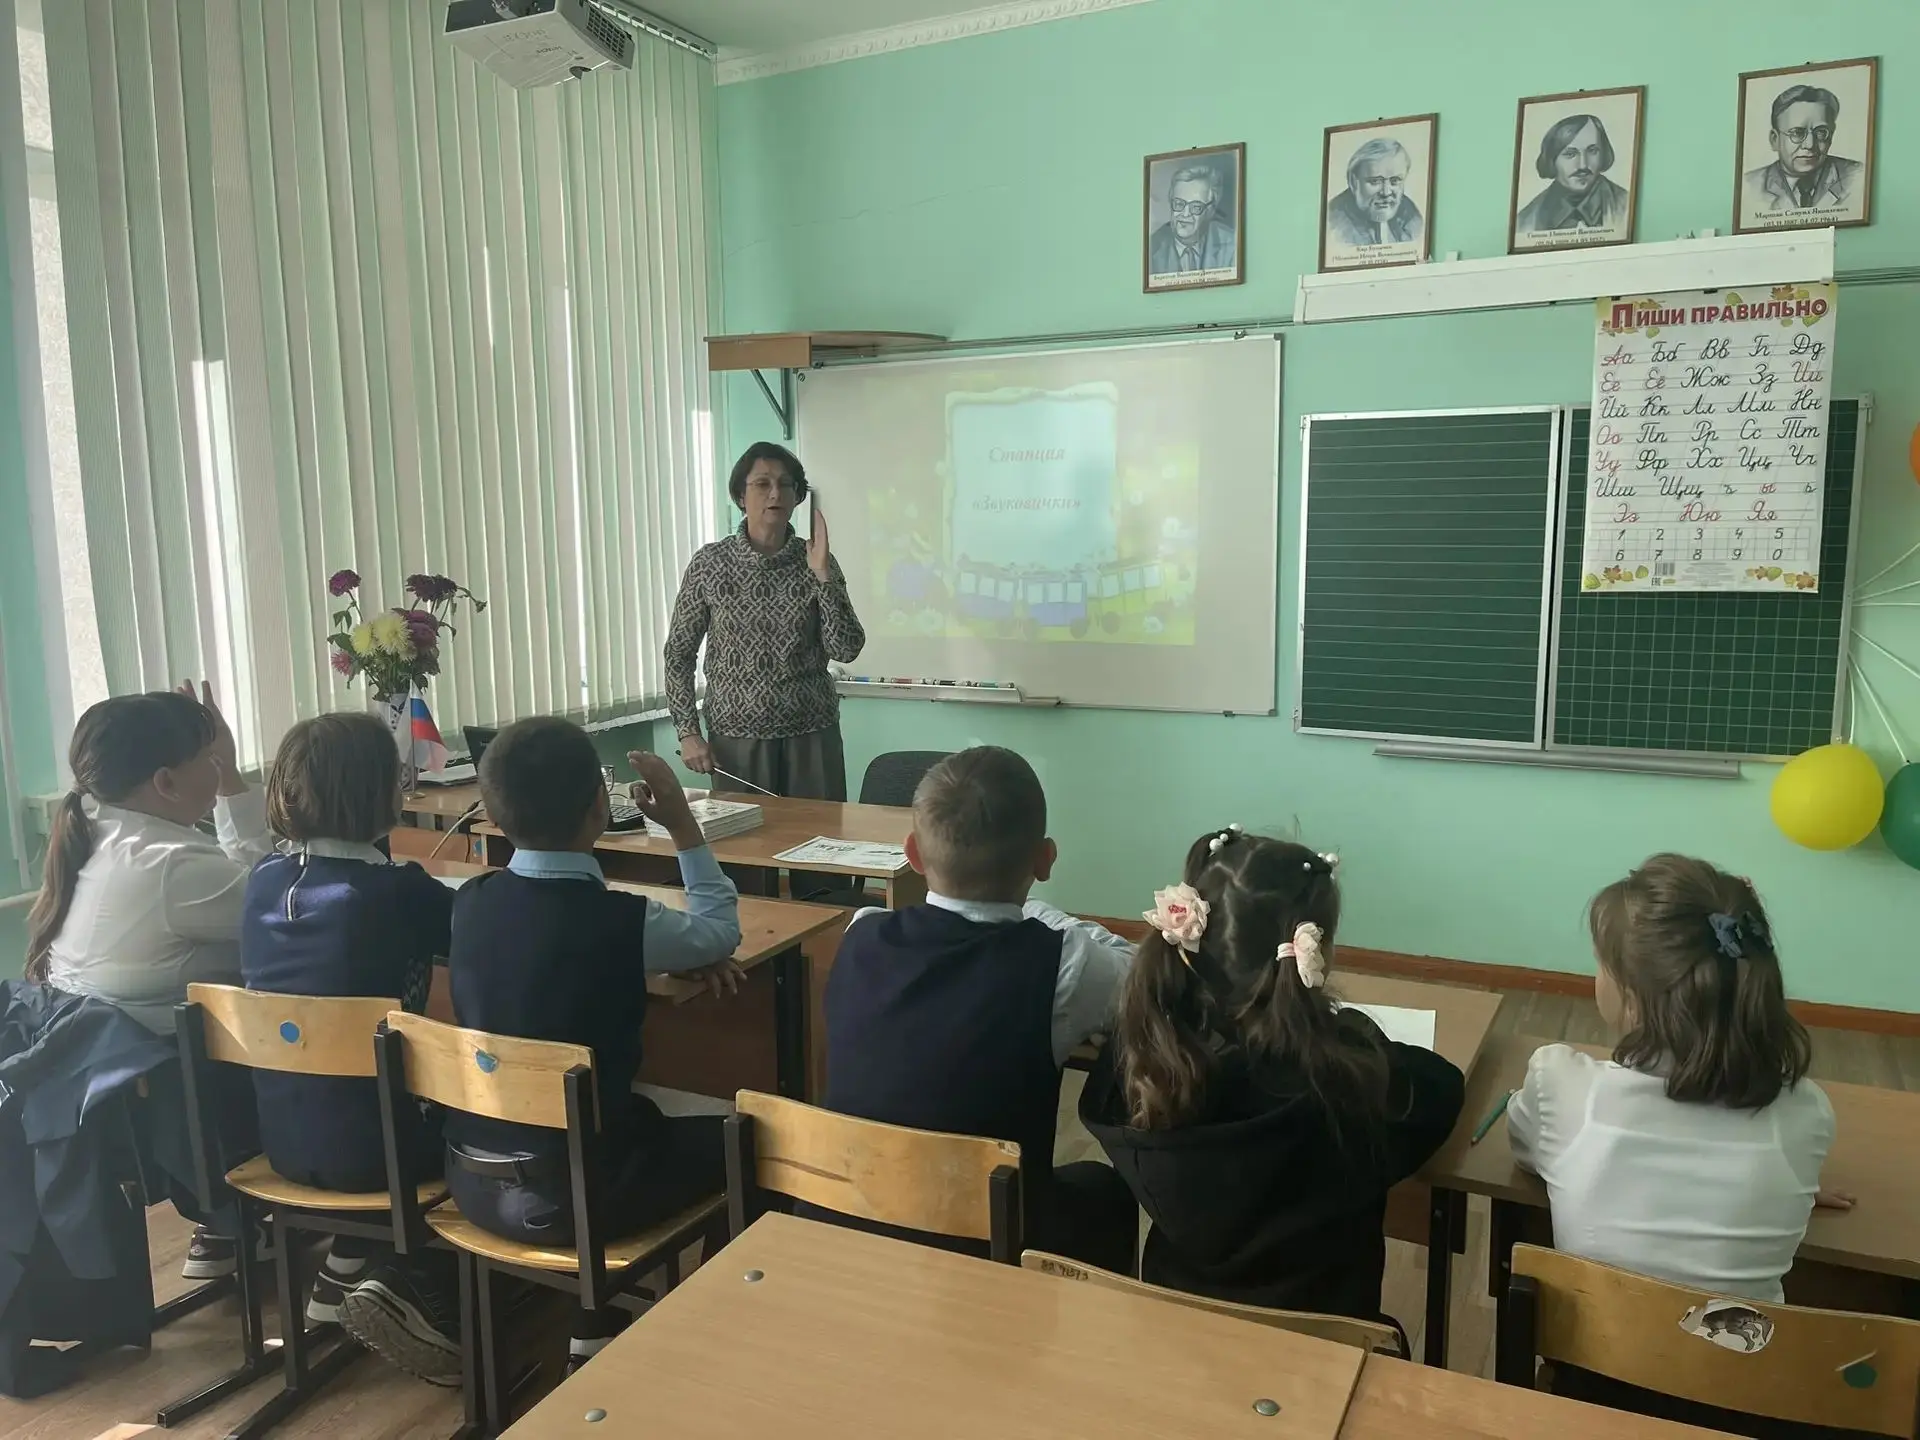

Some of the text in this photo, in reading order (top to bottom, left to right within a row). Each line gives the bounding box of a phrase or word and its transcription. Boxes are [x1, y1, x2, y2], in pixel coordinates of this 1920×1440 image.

[1690, 298, 1827, 323] ПРАВИЛЬНО
[1601, 333, 1825, 366] Аа Бб Вв Гг Дд
[1601, 361, 1823, 393] Ее Ёё Жж Зз Ии
[1600, 389, 1822, 419] Йй Кк Лл Мм Нн
[1597, 417, 1820, 448] Оо Пп Рр Сс Тт
[988, 446, 1065, 463] Станция
[1595, 445, 1817, 477] Уу Фф Хх Цц Чч
[1595, 478, 1637, 497] Шш
[1658, 476, 1704, 500] Щщ
[1613, 500, 1778, 523] Ээ Юю Яя
[1617, 527, 1784, 540] 1 2 3 4 5
[1615, 548, 1783, 561] 6 7 8 9 0
